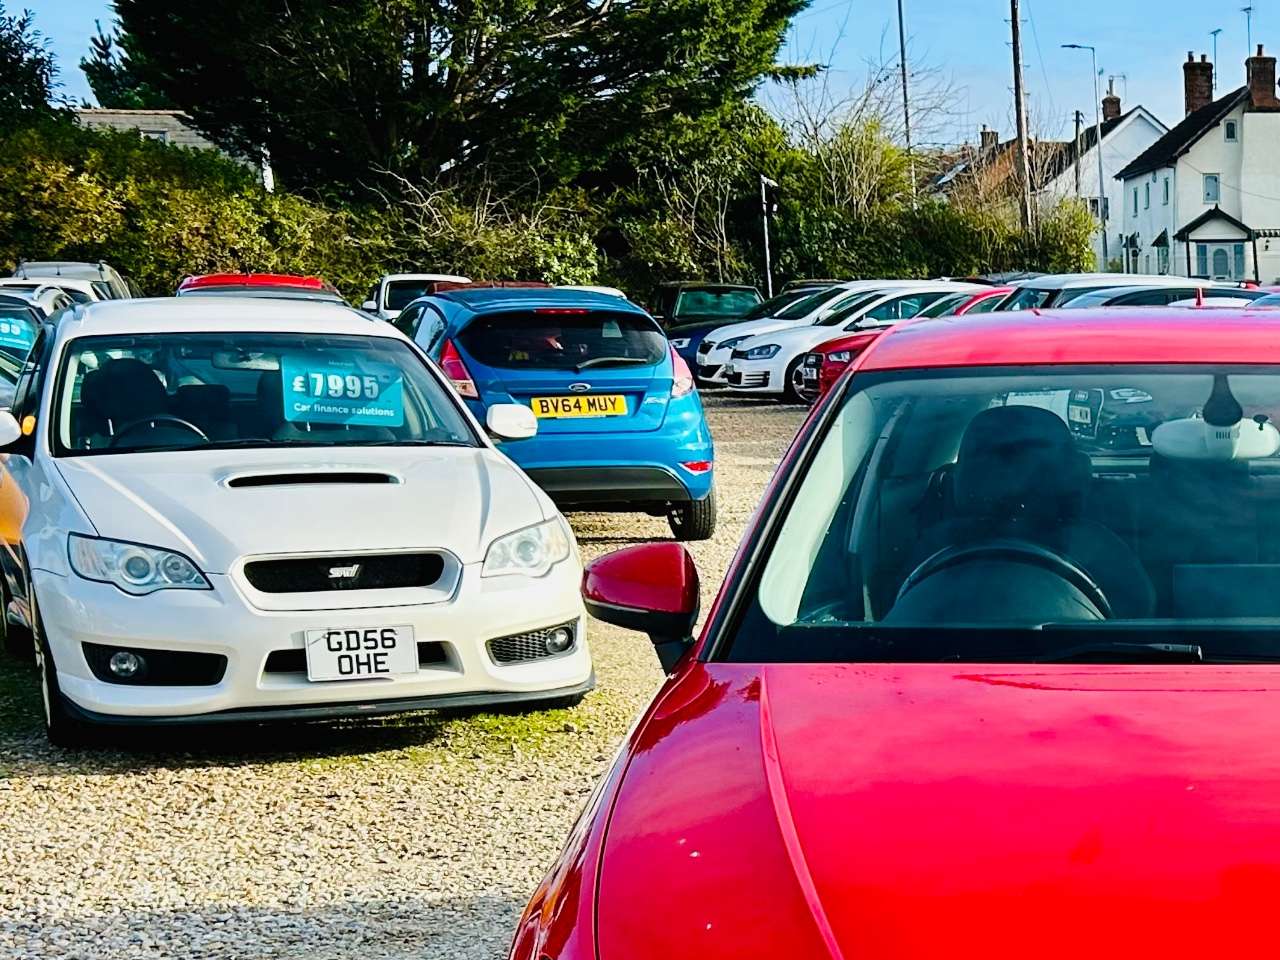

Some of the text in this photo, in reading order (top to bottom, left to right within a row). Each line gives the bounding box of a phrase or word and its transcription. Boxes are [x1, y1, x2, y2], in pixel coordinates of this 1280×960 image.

[293, 402, 395, 417] Car finance solutions
[539, 397, 617, 414] BV64 MUY
[326, 628, 398, 652] GD56
[337, 652, 390, 675] OHE
